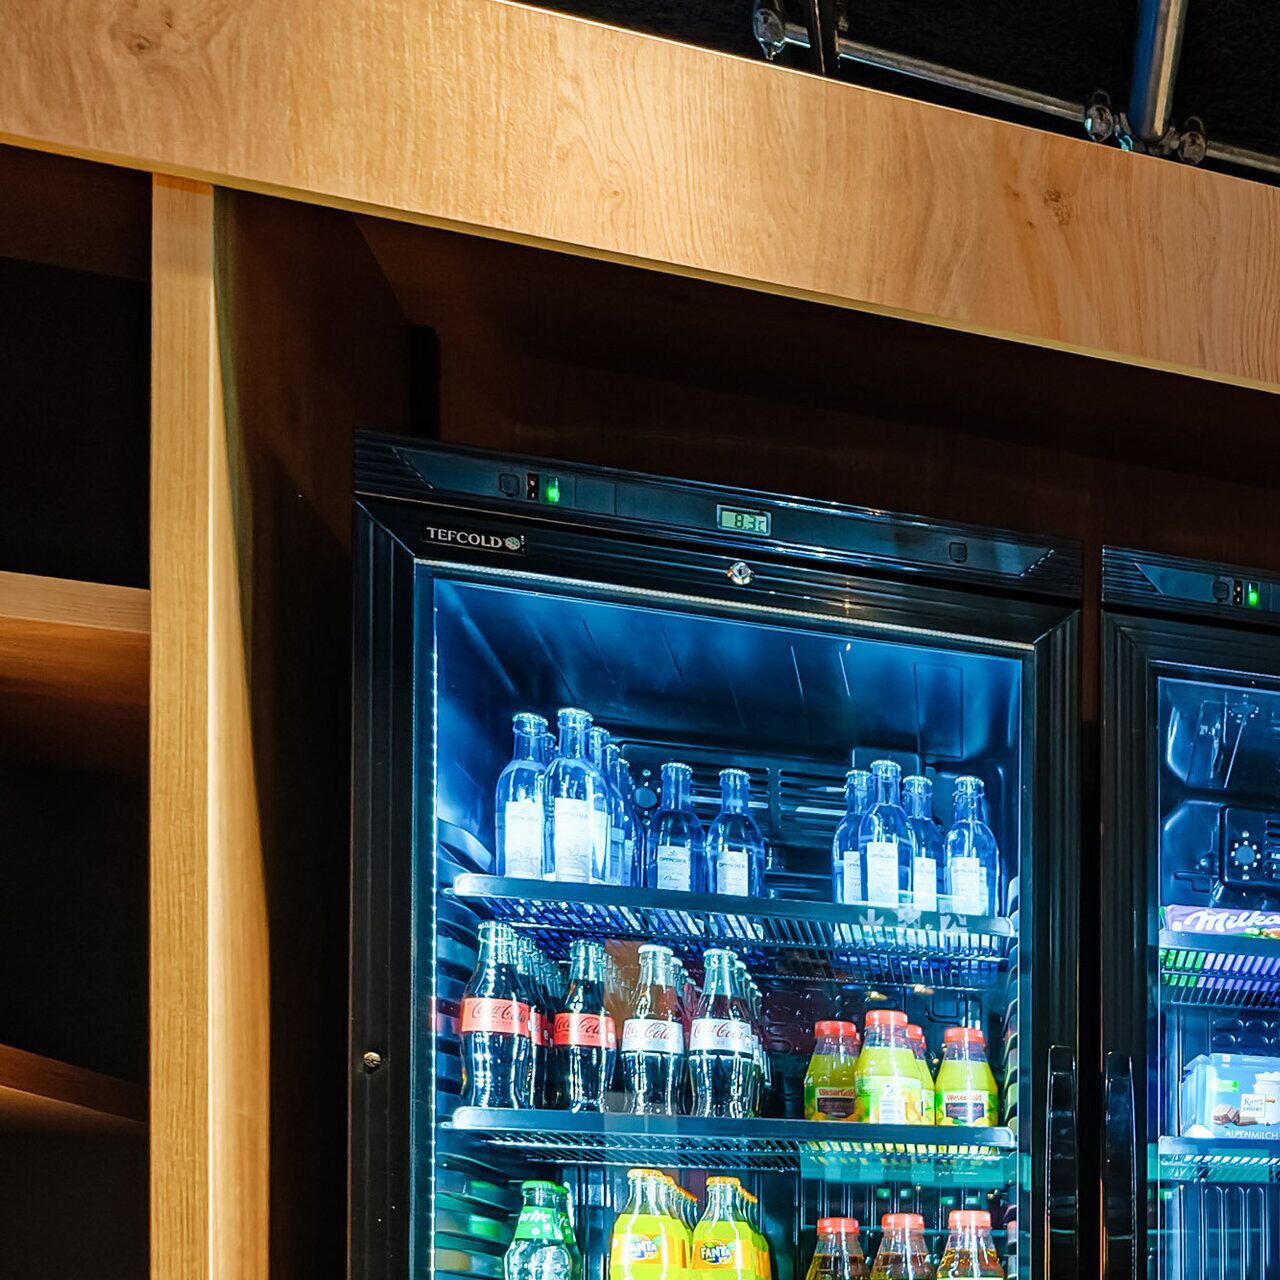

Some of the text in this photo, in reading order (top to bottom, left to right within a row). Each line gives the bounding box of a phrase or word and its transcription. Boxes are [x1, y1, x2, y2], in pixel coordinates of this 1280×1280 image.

[427, 526, 502, 548] TEFCOLD
[1225, 1129, 1279, 1139] ALPENMILCH
[700, 1246, 731, 1261] FANTA
